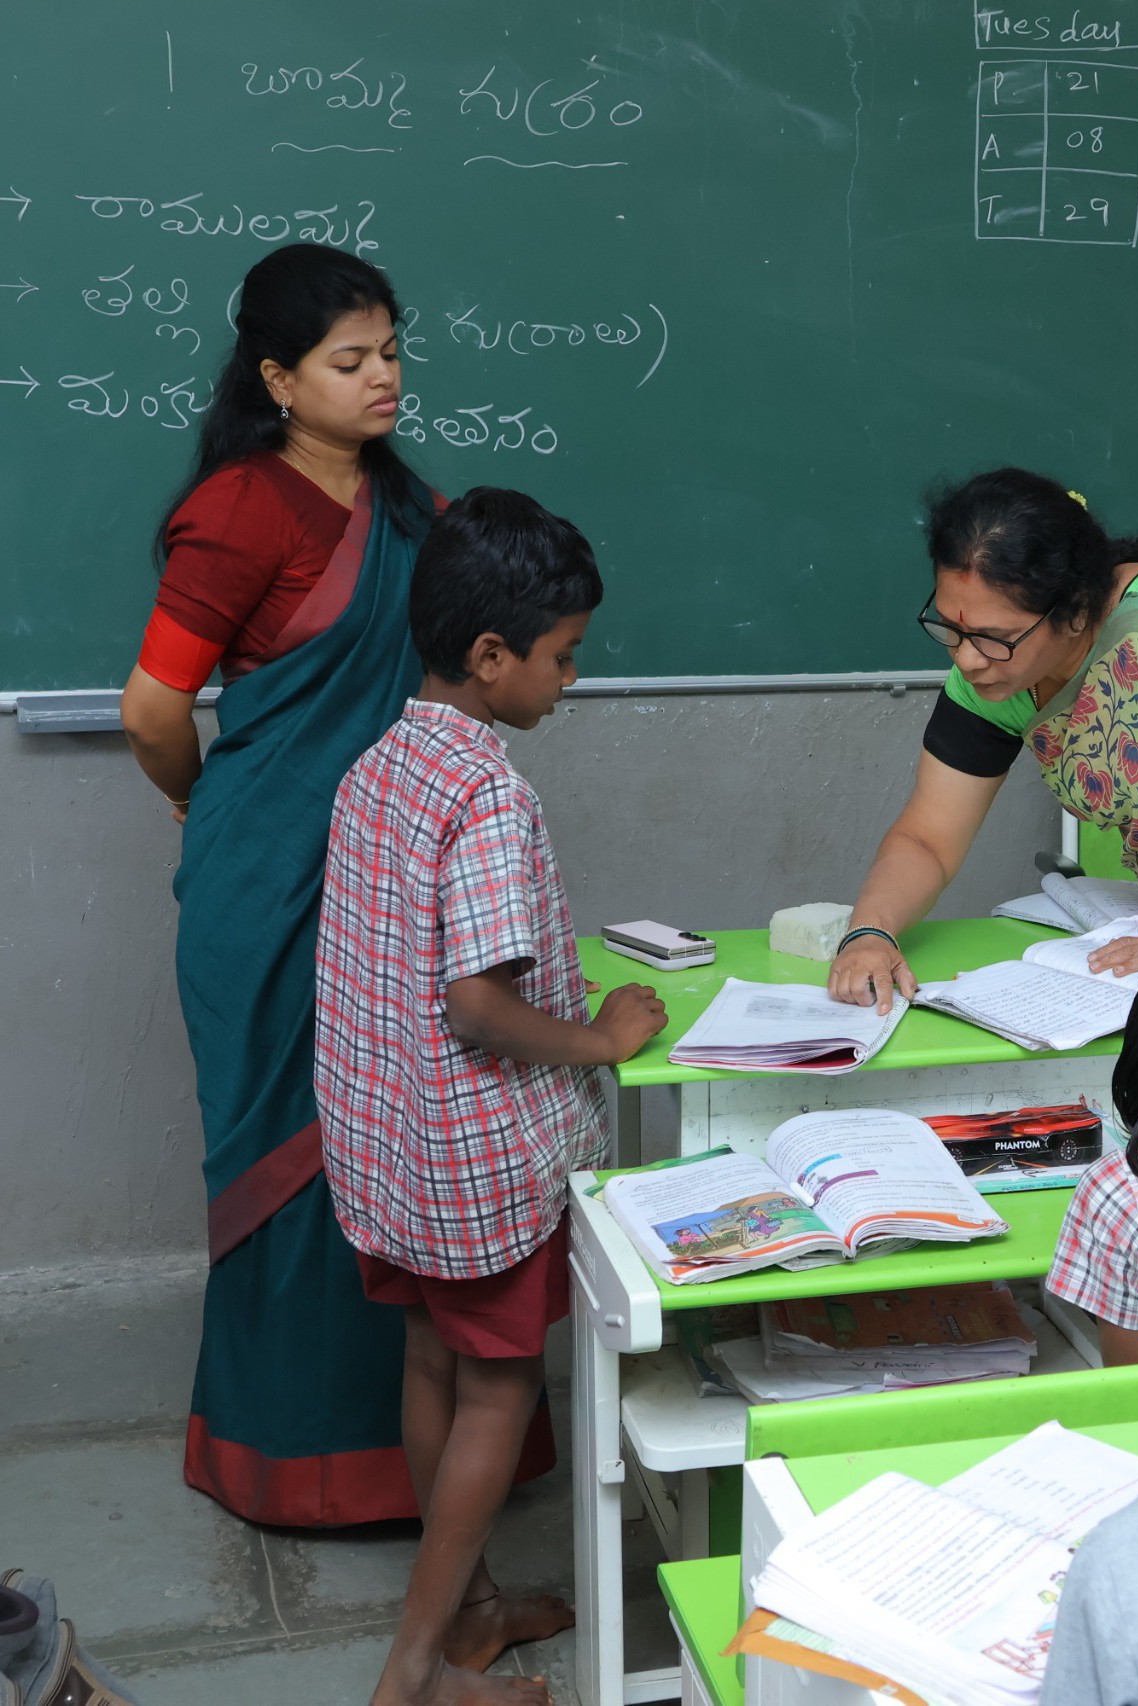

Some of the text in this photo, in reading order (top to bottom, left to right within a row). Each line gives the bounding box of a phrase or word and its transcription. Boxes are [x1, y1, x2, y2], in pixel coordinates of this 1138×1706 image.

[978, 10, 1120, 47] Tuesday
[994, 71, 1098, 105] P 21
[982, 127, 1103, 159] A 08
[980, 195, 1108, 226] T 29
[995, 1140, 1040, 1150] PHANTOM
